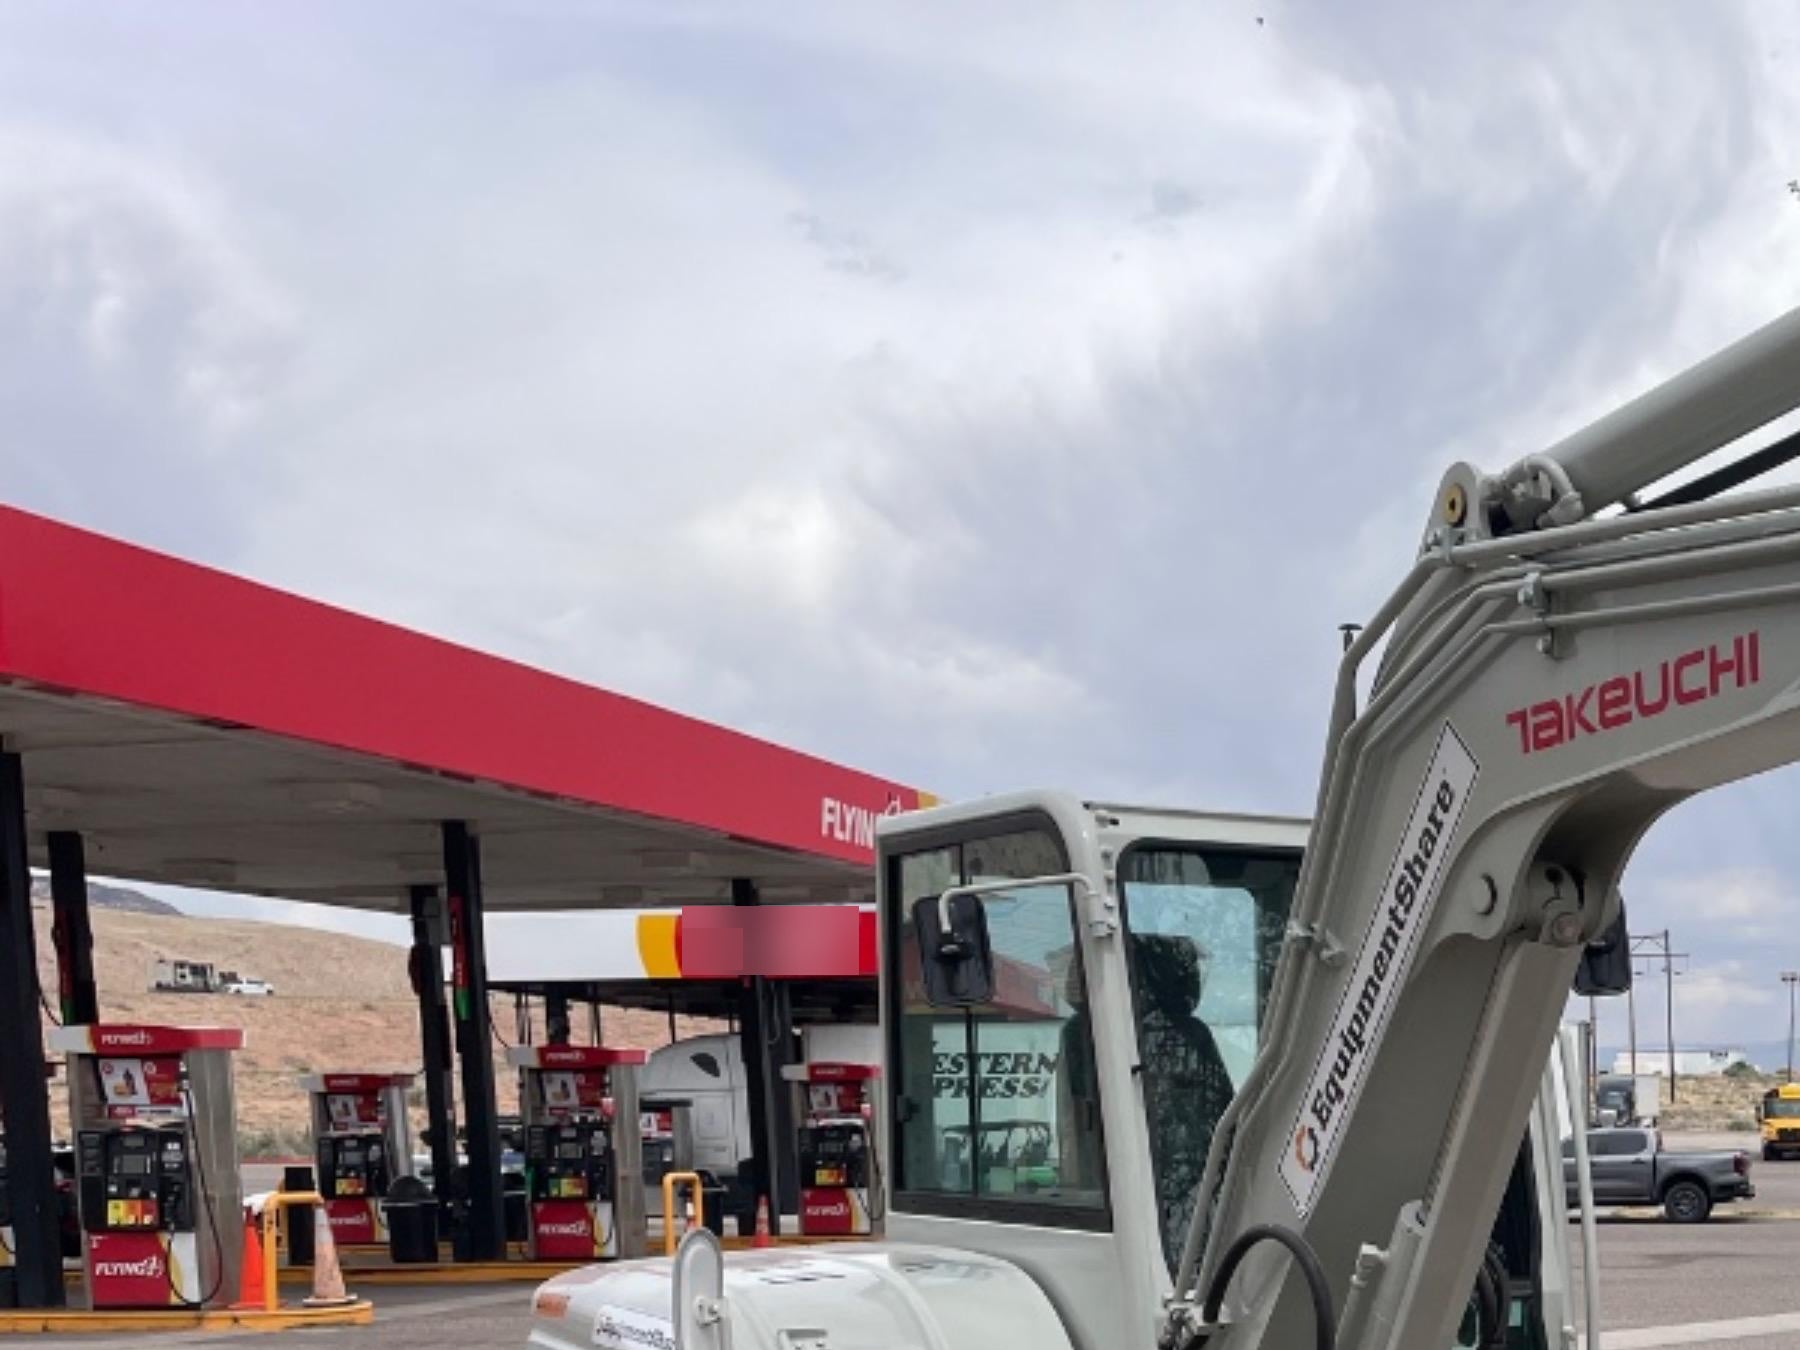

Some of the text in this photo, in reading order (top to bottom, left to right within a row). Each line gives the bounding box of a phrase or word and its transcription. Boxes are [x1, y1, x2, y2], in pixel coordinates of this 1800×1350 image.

[821, 797, 876, 850] FLYIN
[1310, 776, 1456, 1132] EquipmentShare
[932, 1052, 1060, 1075] ESTERN
